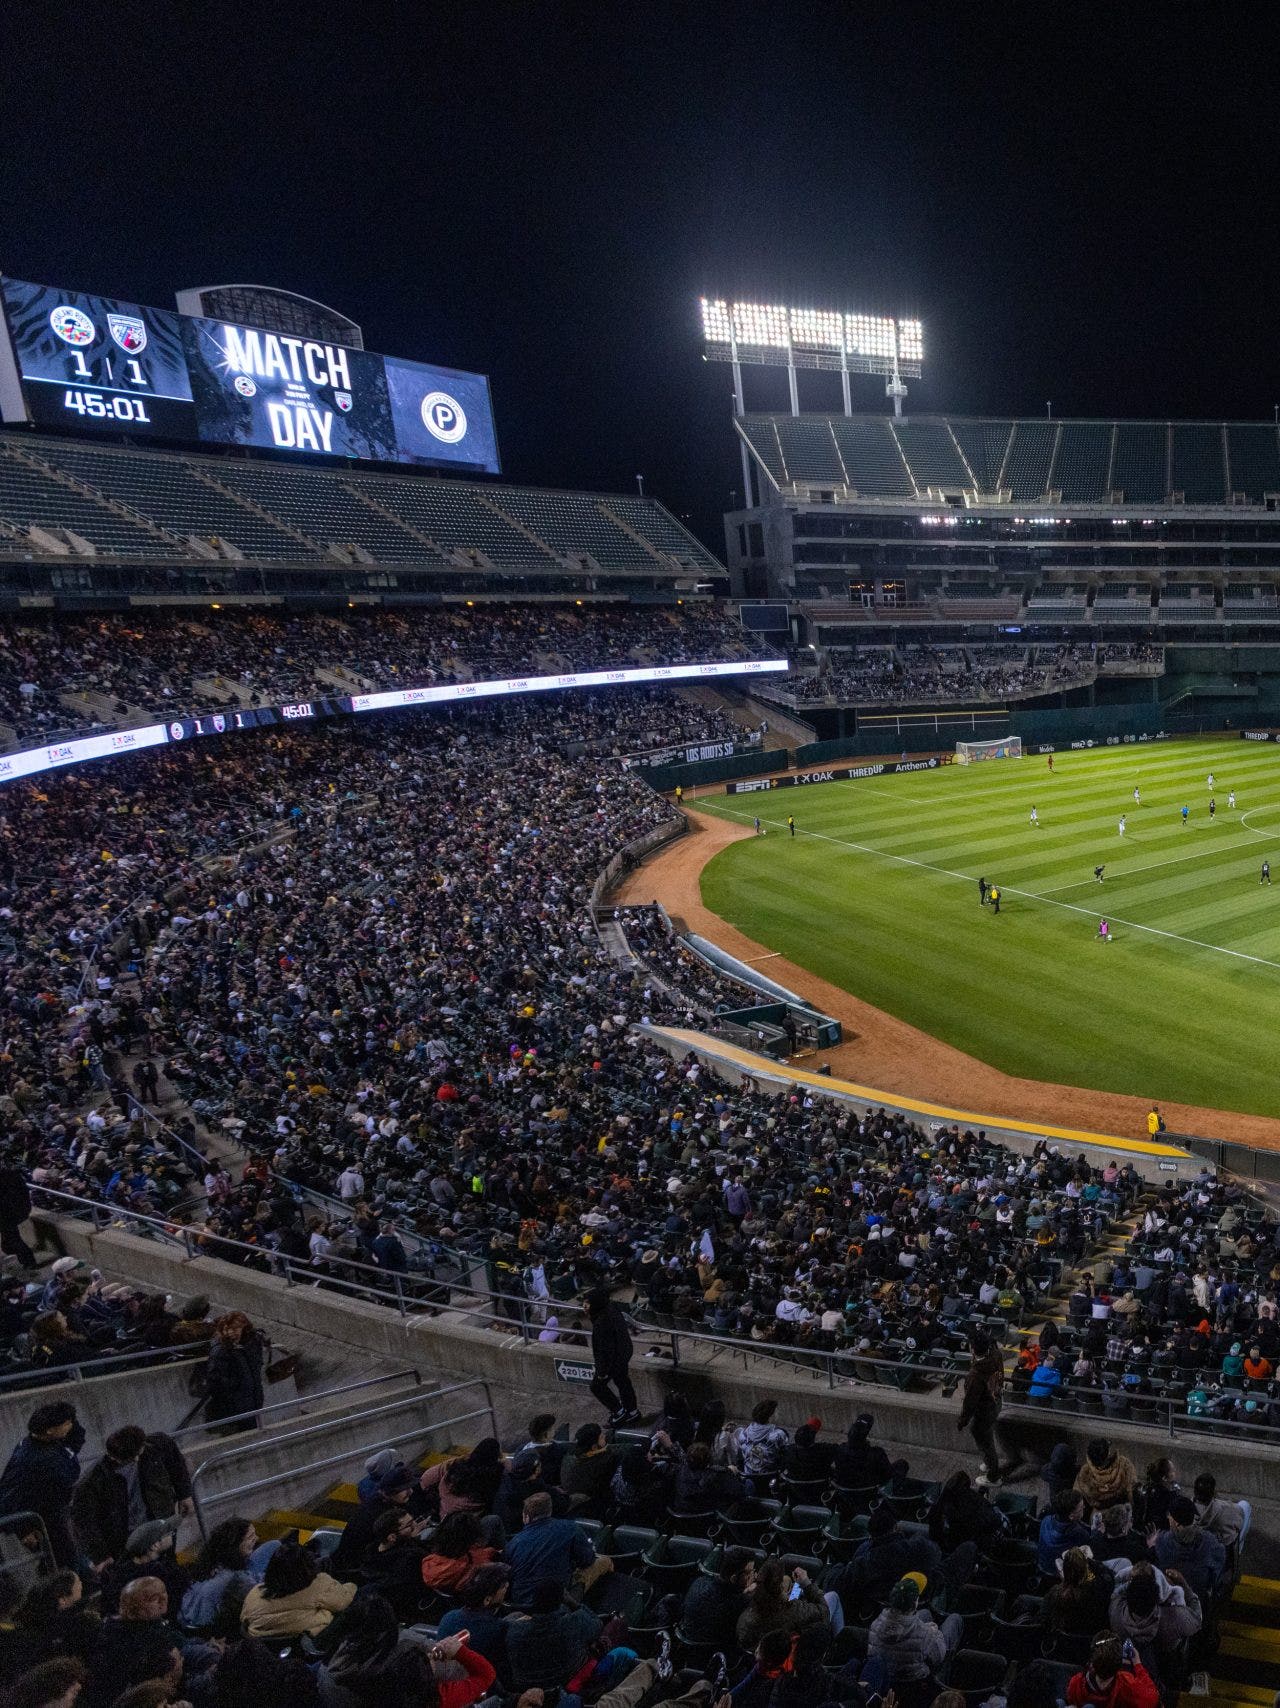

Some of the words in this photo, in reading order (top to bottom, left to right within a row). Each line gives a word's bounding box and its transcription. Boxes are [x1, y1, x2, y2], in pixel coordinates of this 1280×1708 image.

[71, 351, 92, 377] 1
[127, 359, 147, 385] 1
[223, 325, 351, 390] MATCH
[65, 390, 150, 423] 45:01
[436, 405, 453, 429] P
[269, 403, 333, 452] DAY
[195, 720, 204, 734] 1
[235, 714, 244, 727] 1
[282, 703, 314, 719] 45:01
[686, 748, 699, 762] LOS
[700, 744, 723, 760] ROOTS
[813, 771, 834, 783] OAK
[848, 764, 884, 778] THREDUP
[895, 761, 928, 772] Anthem
[561, 1367, 578, 1376] 220
